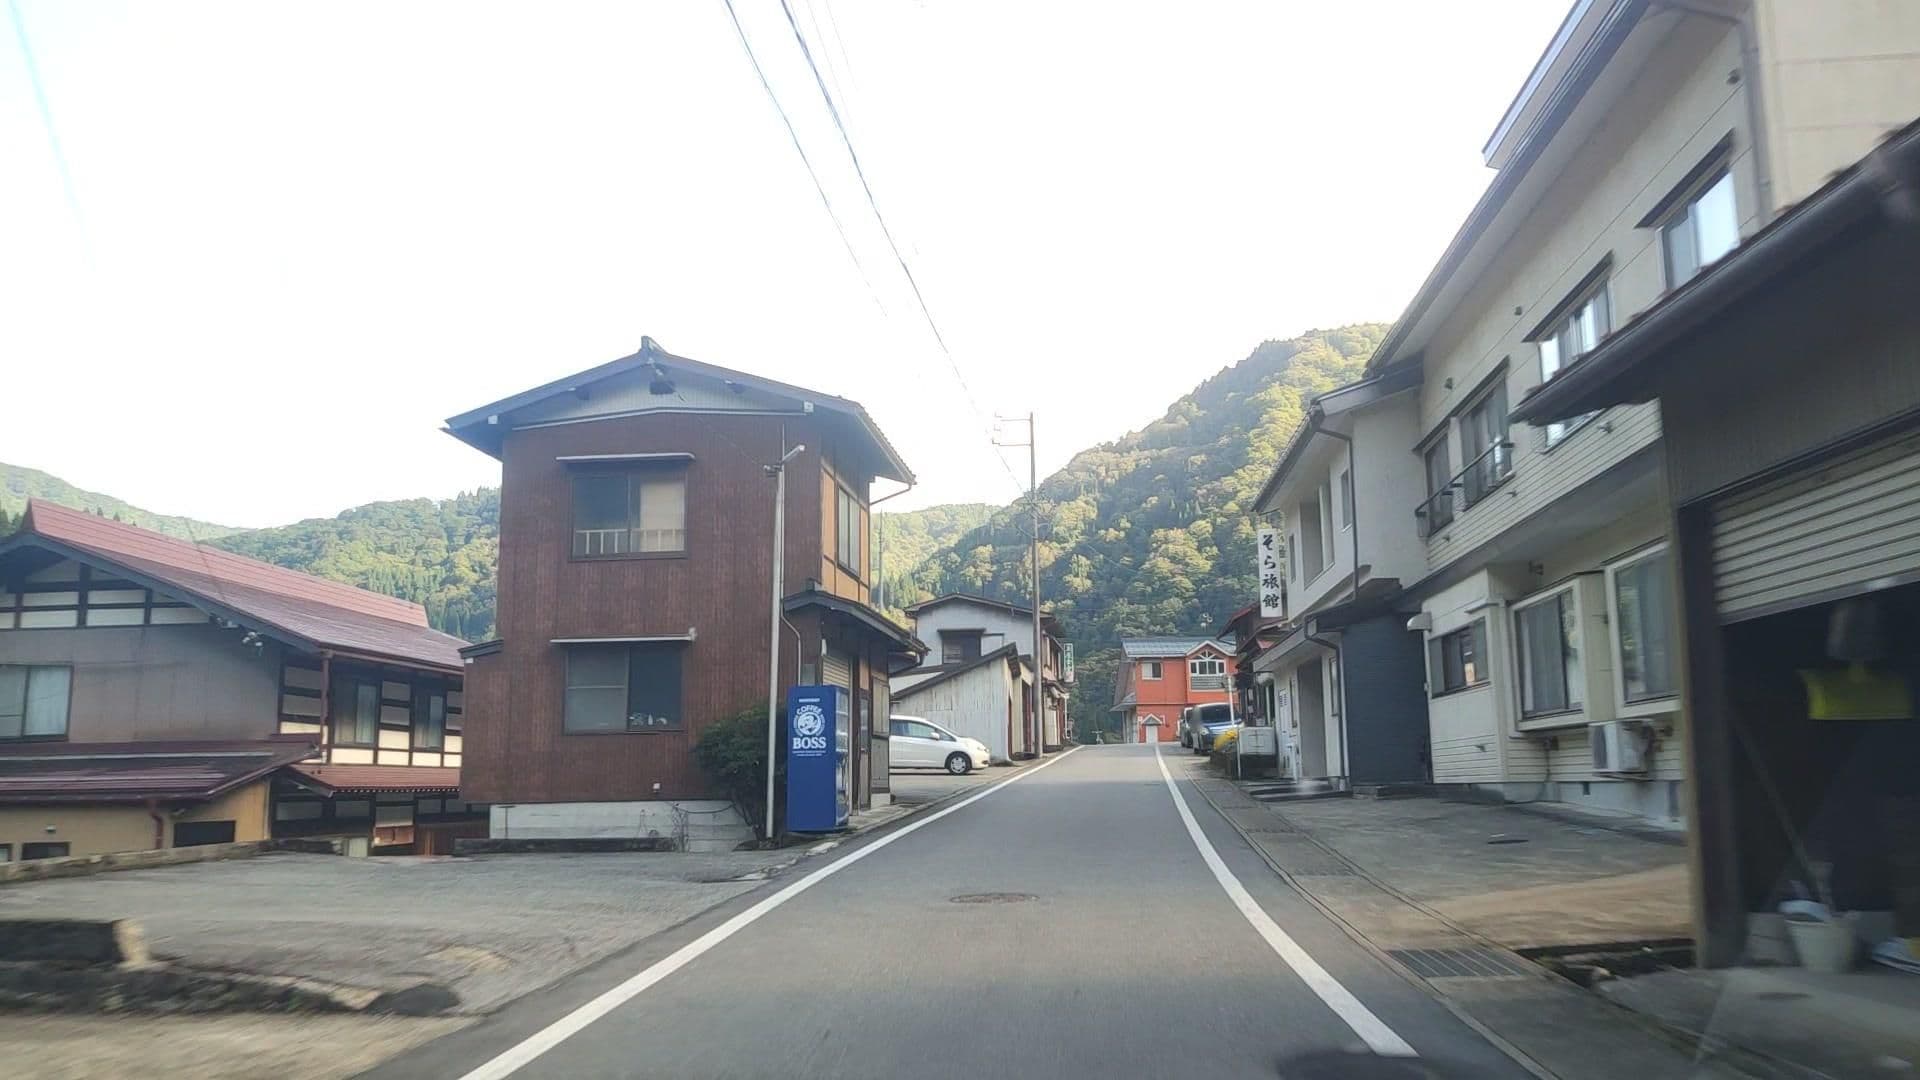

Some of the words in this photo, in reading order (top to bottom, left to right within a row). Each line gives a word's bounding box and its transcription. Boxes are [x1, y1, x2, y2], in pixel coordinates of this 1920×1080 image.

[1262, 534, 1280, 609] そら旅館
[796, 704, 823, 715] COFFEE
[792, 736, 827, 749] BOSS
